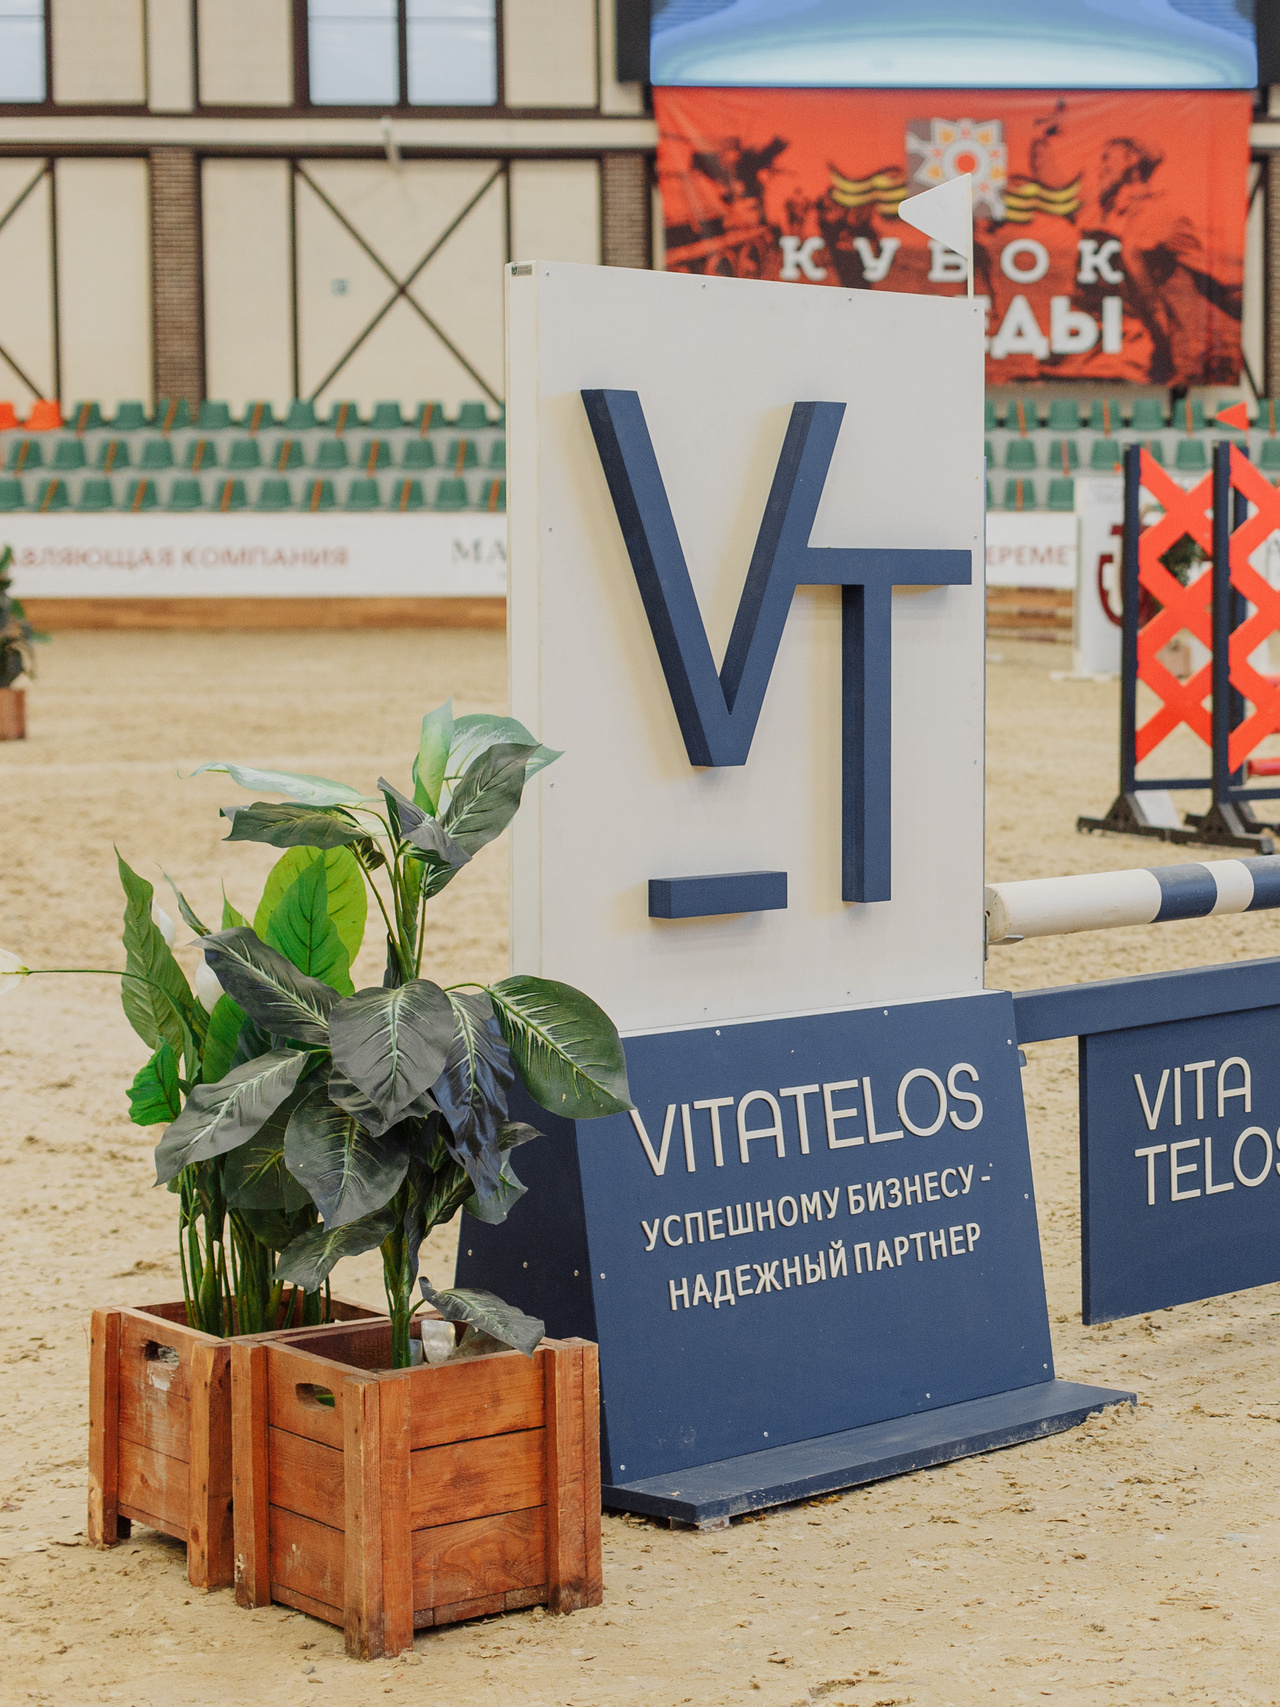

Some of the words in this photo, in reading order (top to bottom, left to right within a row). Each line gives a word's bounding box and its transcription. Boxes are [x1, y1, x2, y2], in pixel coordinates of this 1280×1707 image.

[779, 236, 1125, 284] КУБОК
[985, 294, 1124, 360] ДЫ
[181, 547, 349, 569] КОМПАНИЯ
[629, 1062, 984, 1176] VITATELOS
[1134, 1056, 1252, 1130] VITA
[641, 1187, 840, 1252] УСПЕШНОМУ
[847, 1164, 974, 1216] БИЗНЕСУ
[669, 1239, 848, 1311] НАДЕЖНЫЙ
[853, 1222, 981, 1274] ПАРТНЕР
